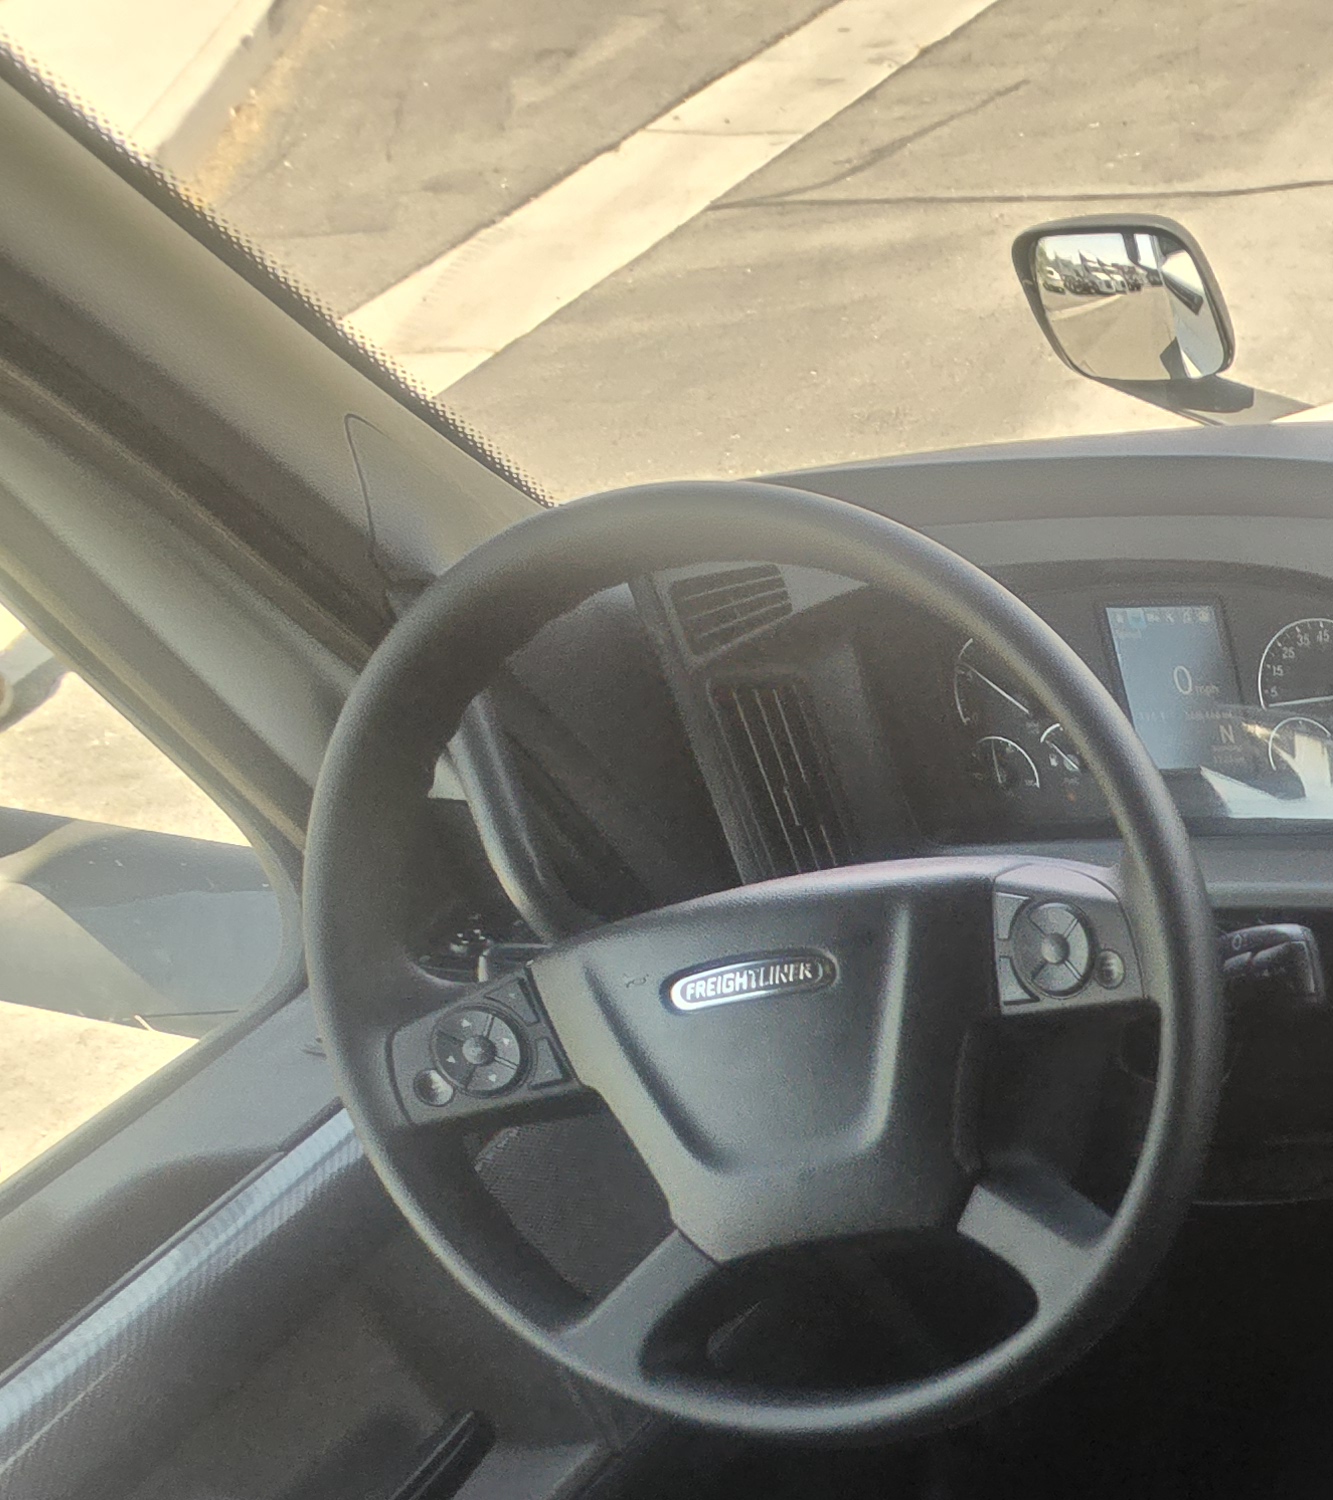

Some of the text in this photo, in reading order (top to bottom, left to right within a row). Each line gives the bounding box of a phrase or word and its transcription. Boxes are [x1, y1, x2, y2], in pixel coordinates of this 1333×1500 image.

[1282, 647, 1296, 659] 25
[1173, 665, 1193, 695] 0
[1272, 665, 1284, 676] 15
[1219, 724, 1236, 744] N
[685, 962, 813, 1001] FREIGHTLINER
